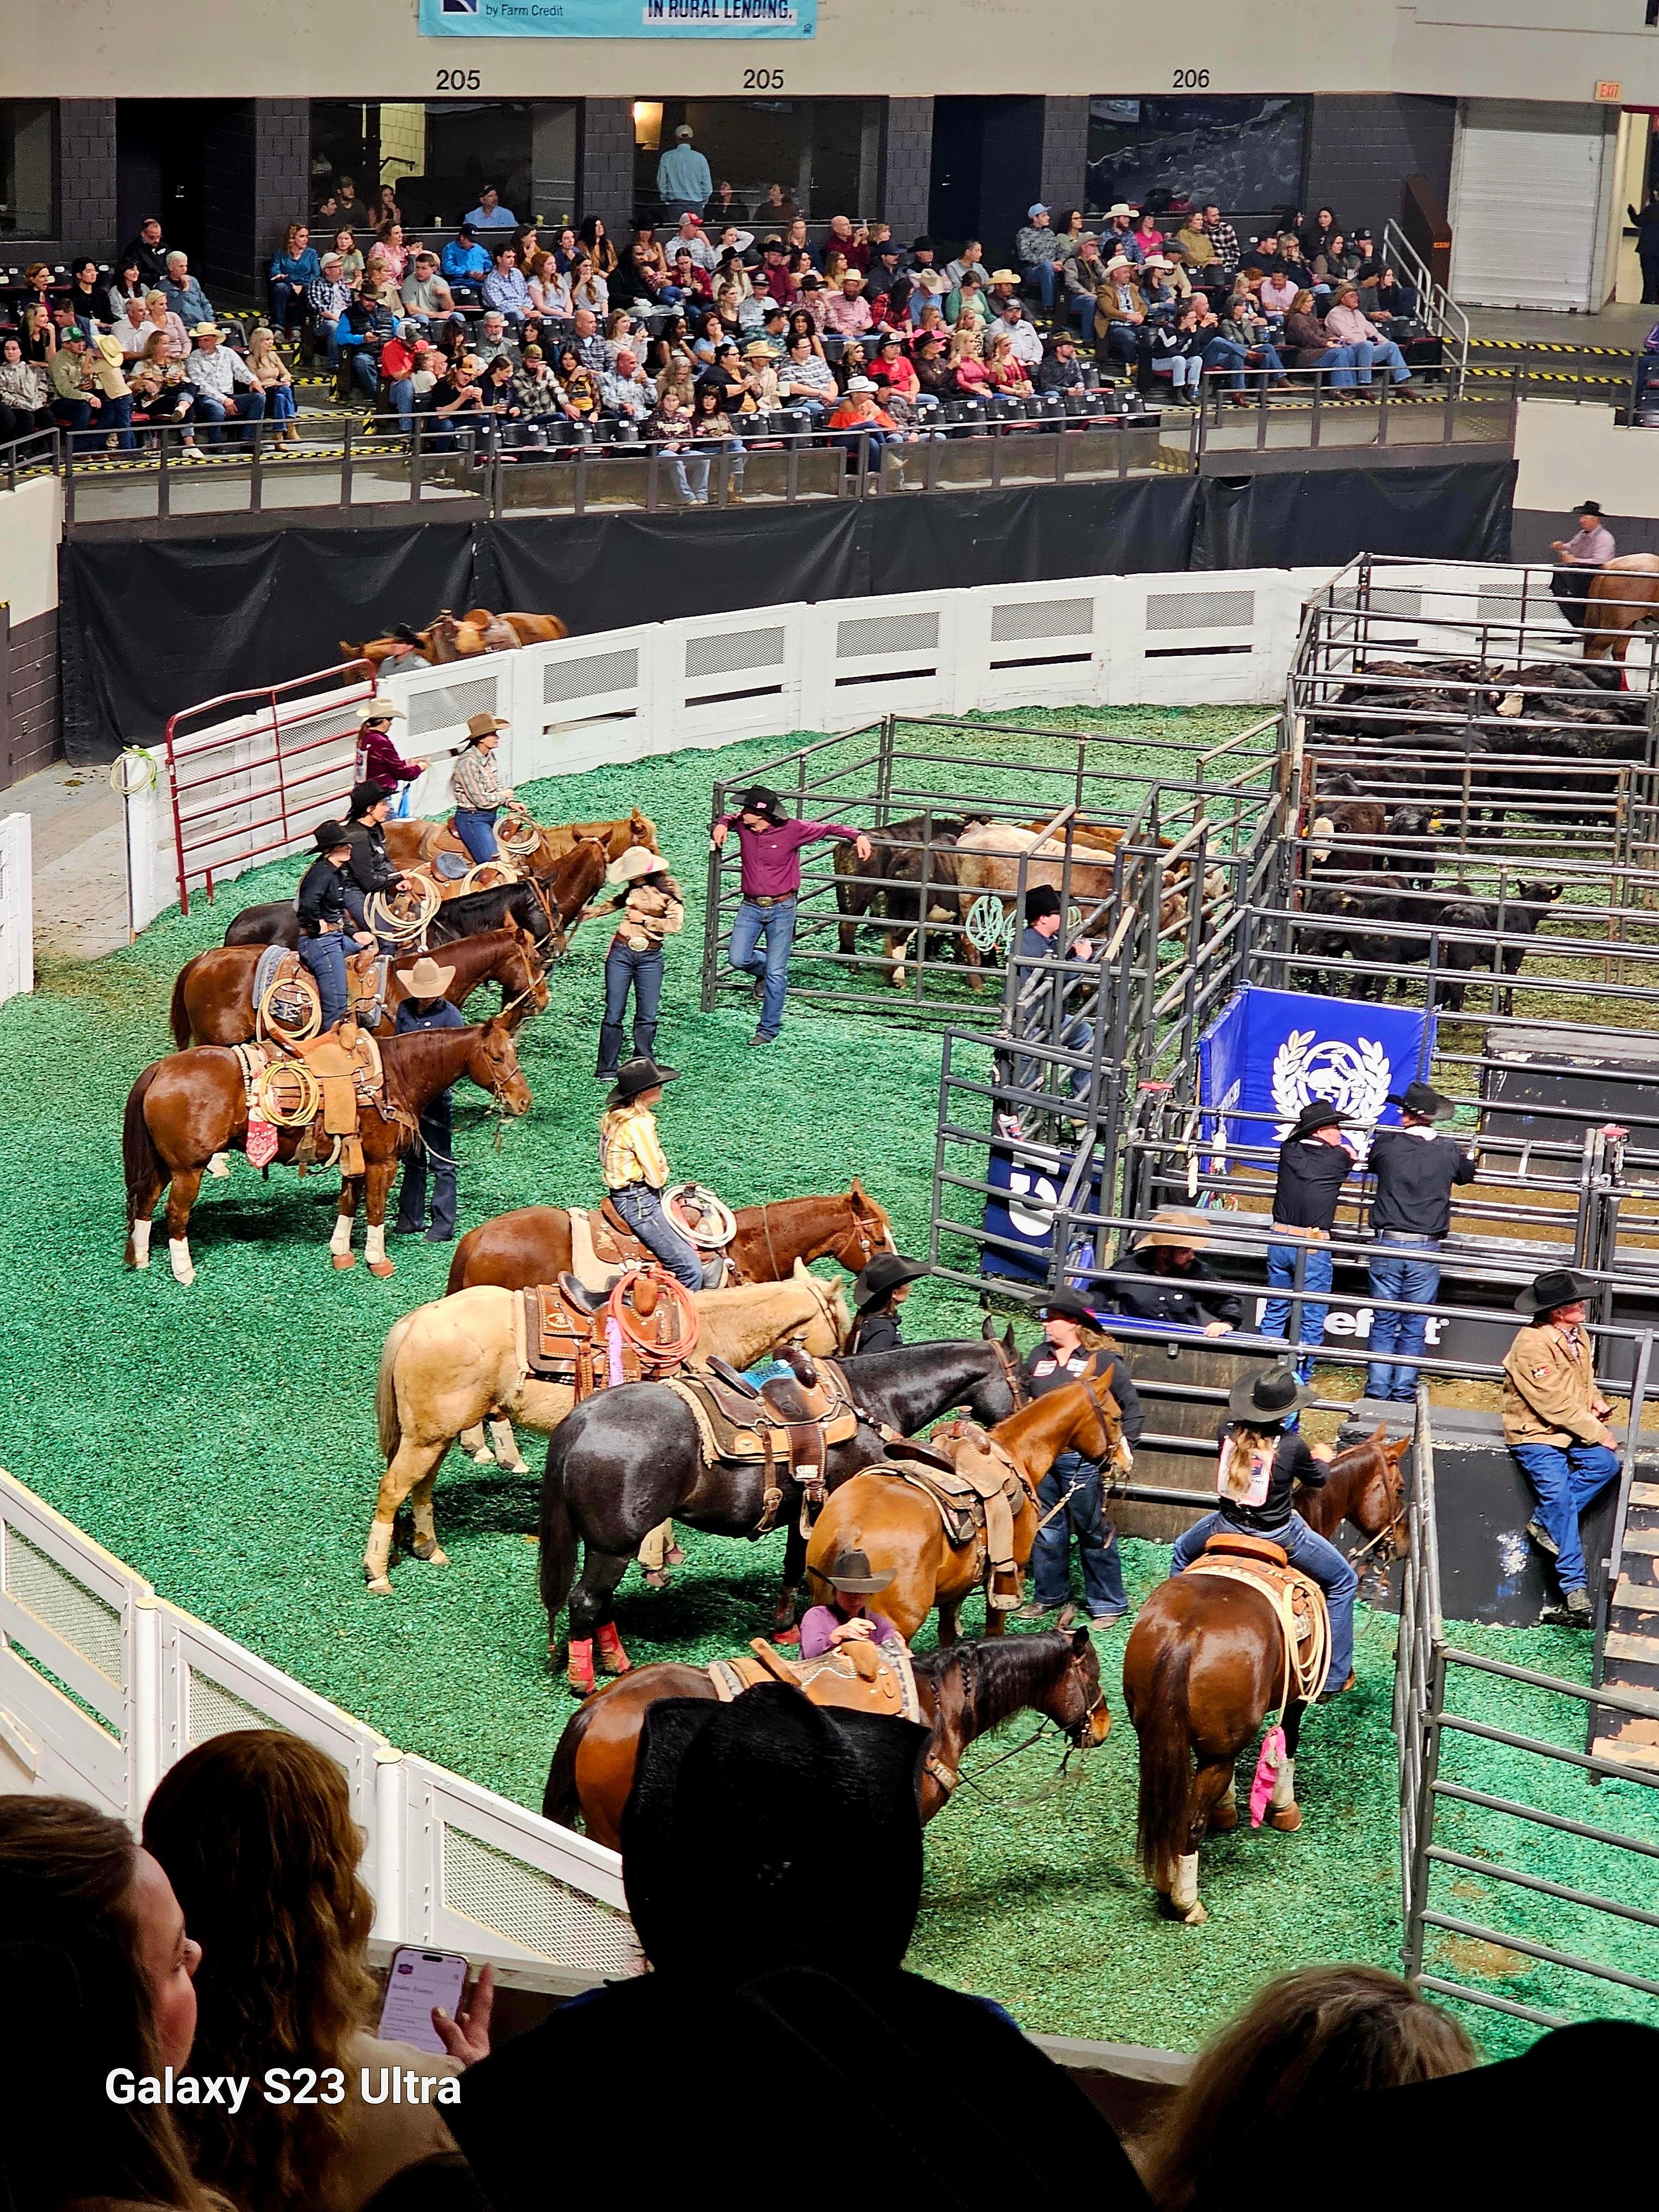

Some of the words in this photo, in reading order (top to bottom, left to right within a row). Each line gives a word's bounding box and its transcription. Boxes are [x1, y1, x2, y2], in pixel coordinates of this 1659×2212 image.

[486, 4, 498, 17] by
[501, 4, 529, 15] Farm
[531, 4, 564, 17] Credit
[648, 0, 664, 18] IN
[669, 0, 719, 18] RURAL
[724, 0, 792, 19] LENDING.
[436, 69, 481, 91] 205
[743, 69, 784, 90] 205
[1172, 69, 1210, 88] 206
[1600, 84, 1619, 97] EXIT
